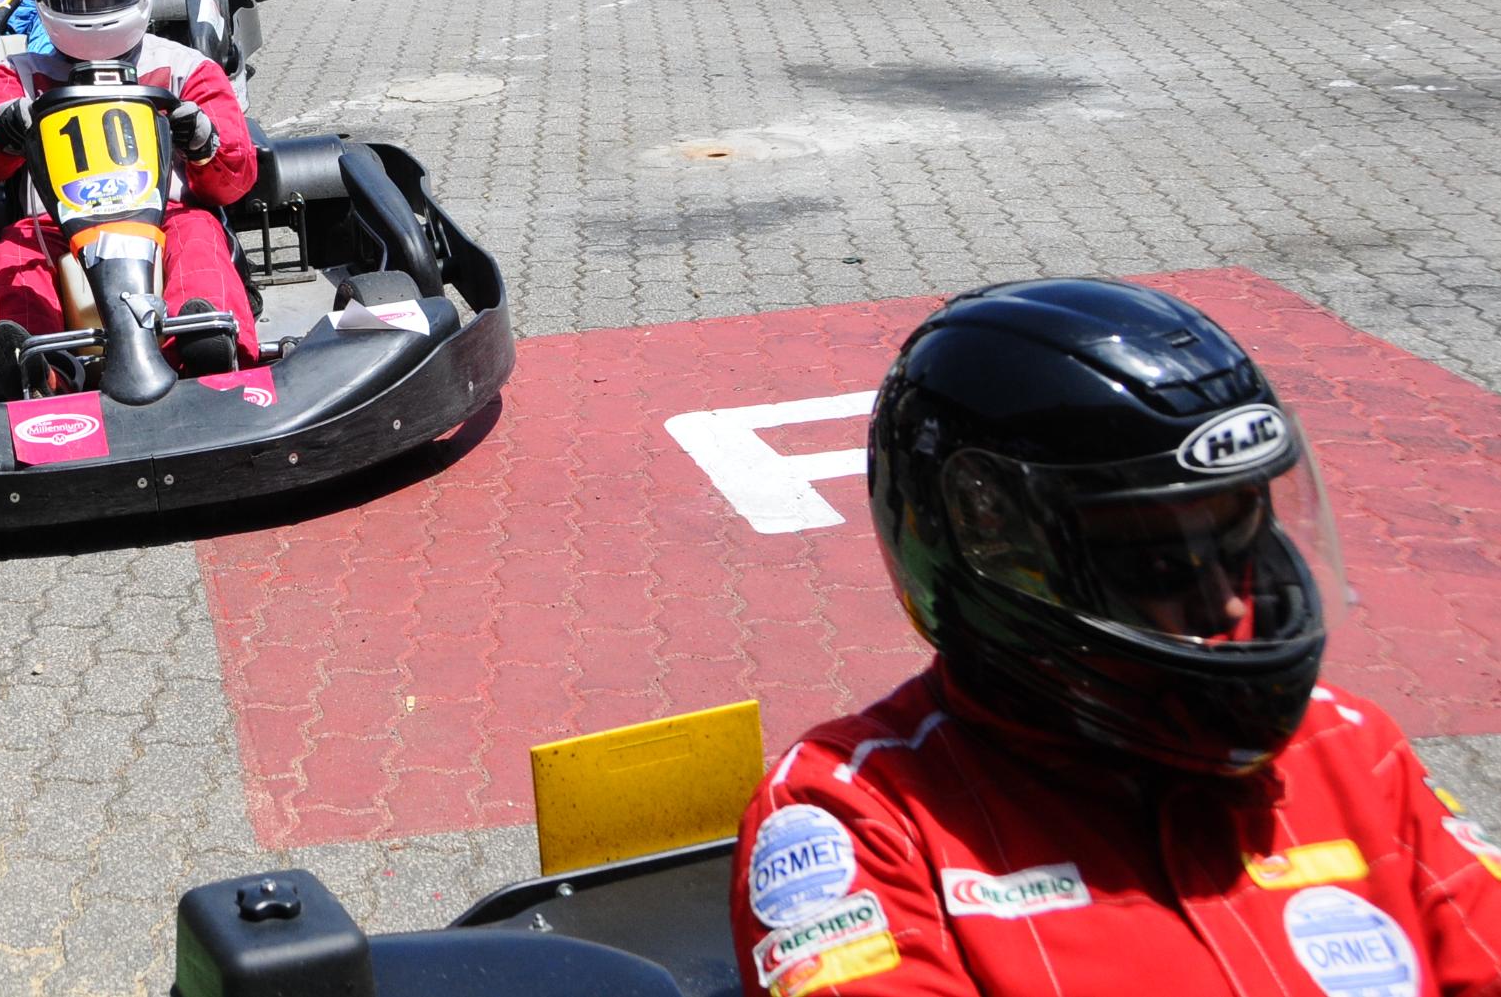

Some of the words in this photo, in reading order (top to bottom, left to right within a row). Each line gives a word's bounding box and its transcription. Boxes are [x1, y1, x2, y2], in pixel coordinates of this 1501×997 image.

[59, 108, 139, 174] 10
[27, 422, 84, 435] Millennium
[1207, 415, 1278, 462] HJC
[980, 876, 1076, 904] RECHEIO
[779, 905, 874, 955] RECHEIO
